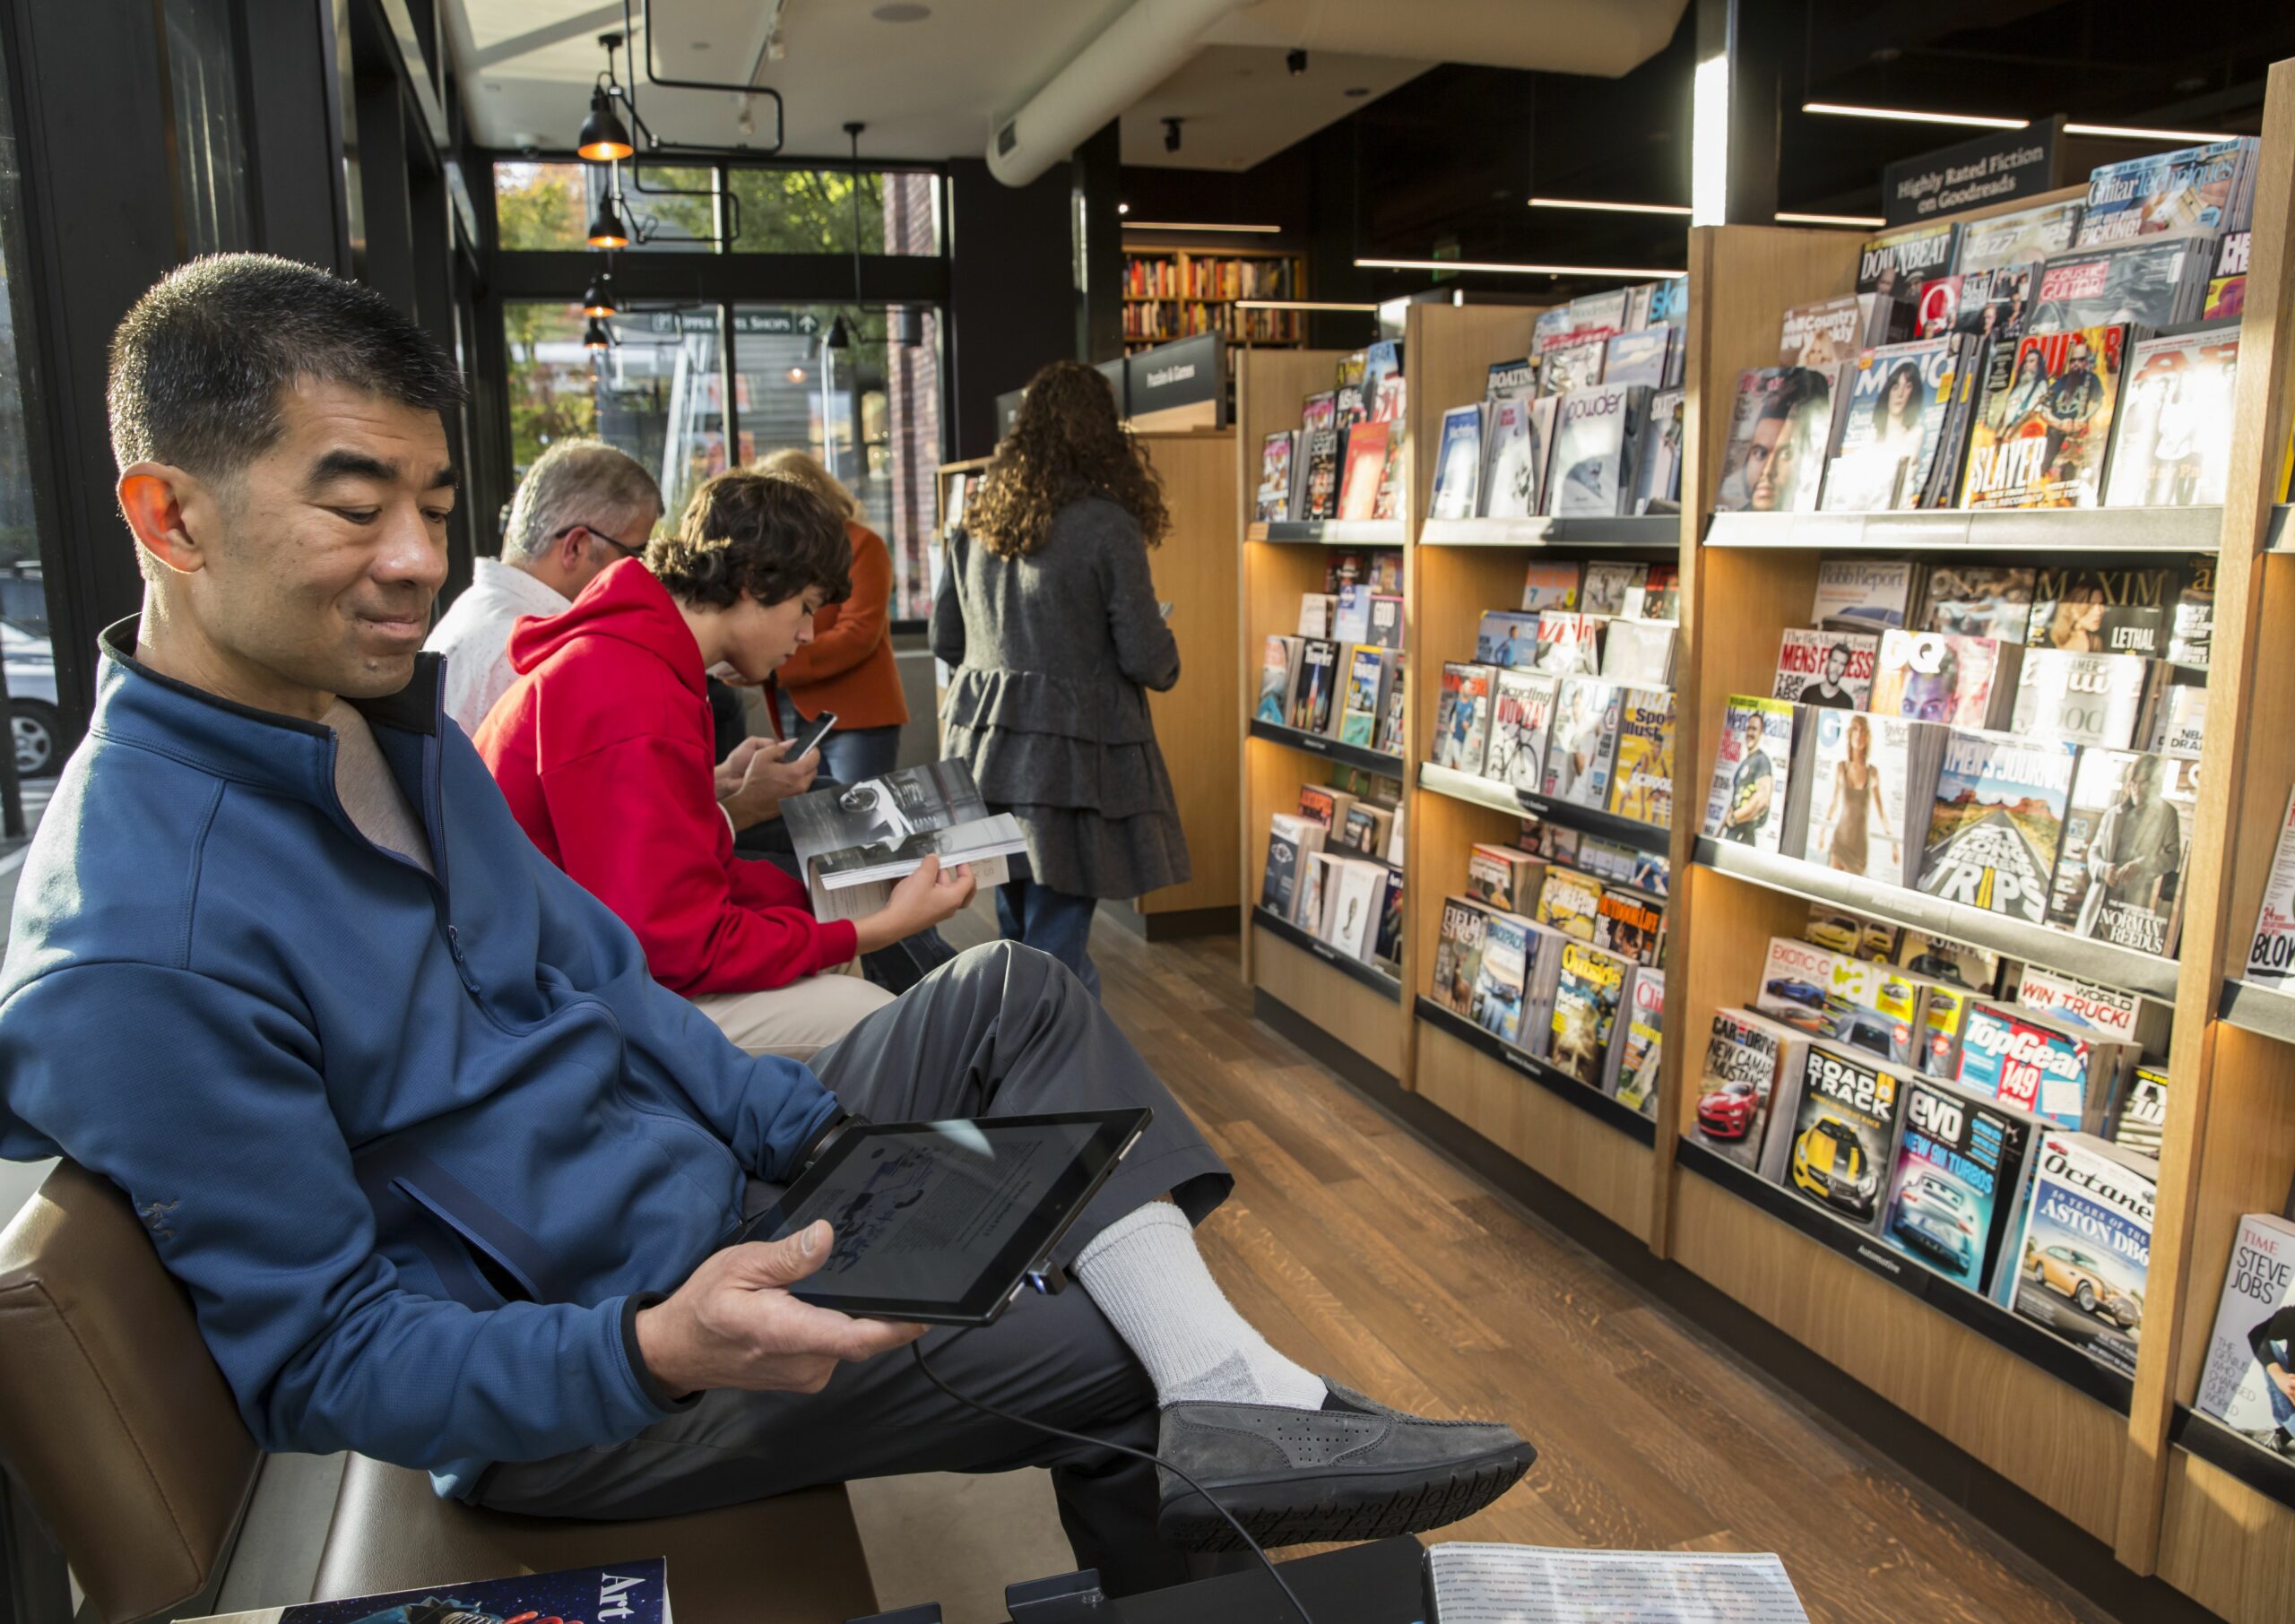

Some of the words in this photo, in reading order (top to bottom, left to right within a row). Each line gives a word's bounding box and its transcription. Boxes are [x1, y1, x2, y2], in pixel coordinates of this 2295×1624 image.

[1897, 172, 1944, 199] Highly
[1945, 158, 1987, 186] Rated
[1989, 146, 2044, 173] Fiction
[2087, 176, 2139, 206] Guitar
[2137, 159, 2235, 197] Techniques
[1918, 198, 1936, 214] on
[1938, 174, 2016, 208] Goodreads
[2080, 219, 2139, 245] PICKING!
[1860, 234, 1951, 281] DOWNBEAT
[2040, 277, 2100, 302] GUITAR
[1799, 307, 1858, 331] Country
[1919, 283, 1957, 334] Q
[1568, 391, 1624, 420] powder
[1972, 436, 2048, 493] SLAYER
[1821, 565, 1854, 584] Robb
[1857, 567, 1904, 591] Report
[2036, 569, 2169, 607] MXIM
[1880, 628, 1946, 674] GQ
[2111, 626, 2155, 651] LETHAL
[1818, 645, 1875, 680] FESS
[2099, 908, 2168, 937] NORMAN
[2110, 924, 2164, 955] REEDUS
[1771, 945, 1816, 972] EXOTIC
[2022, 981, 2055, 1005] WIN
[2063, 993, 2130, 1030] TRUCK!
[2075, 987, 2133, 1011] WORLD
[1712, 1015, 1738, 1041] CAR
[1964, 1011, 2083, 1081] TopGear
[1808, 1052, 1876, 1094] ROAD
[2002, 1059, 2040, 1099] 149
[1807, 1067, 1892, 1121] TRACK
[1902, 1129, 1931, 1159] NEW
[1930, 1144, 1948, 1166] 911
[1948, 1150, 1995, 1195] TURBOS
[2044, 1153, 2152, 1220] Octane
[2040, 1197, 2109, 1244] ASTON
[2112, 1231, 2151, 1267] DB6
[2051, 1189, 2063, 1202] 50
[2067, 1196, 2106, 1222] YEARS
[2109, 1215, 2125, 1230] OF
[2127, 1224, 2147, 1245] THE
[2243, 1229, 2280, 1256] TIME
[2237, 1246, 2291, 1288] STEVE
[2230, 1270, 2274, 1305] JOBS
[2214, 1348, 2248, 1372] GENIUS
[2218, 1337, 2234, 1352] THE
[2209, 1370, 2256, 1403] CHANGED
[2212, 1361, 2237, 1378] WHO
[2204, 1391, 2239, 1417] WORLD
[2208, 1381, 2228, 1396] OUR
[601, 1571, 646, 1622] Art
